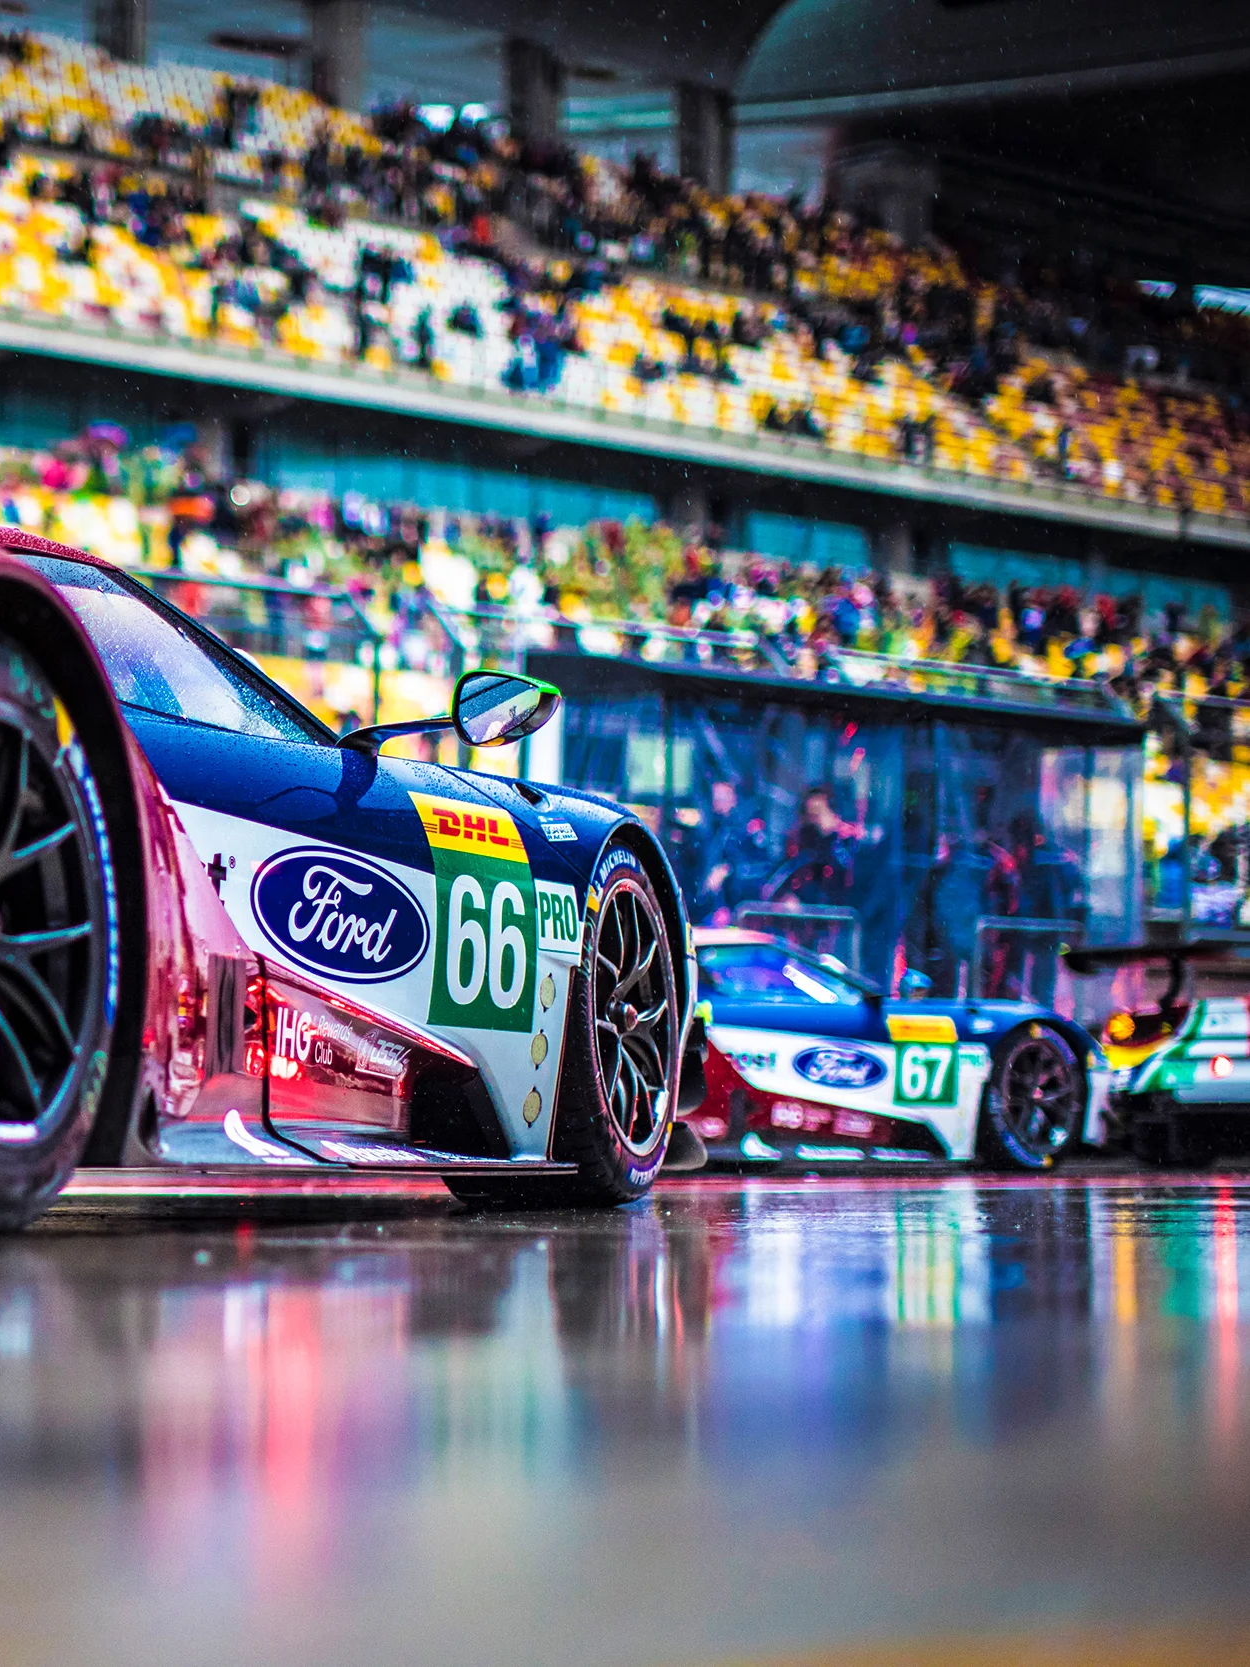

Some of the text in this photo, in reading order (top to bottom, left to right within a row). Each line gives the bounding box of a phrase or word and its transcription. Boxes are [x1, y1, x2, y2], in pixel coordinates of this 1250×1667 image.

[432, 808, 509, 847] DHL
[600, 850, 637, 884] MICHELIN
[288, 865, 398, 963] Ford
[538, 891, 579, 943] PRO
[446, 874, 527, 1009] 66
[275, 1006, 313, 1061] IHG
[314, 1042, 333, 1066] Club
[315, 1015, 353, 1041] Rewards
[901, 1045, 952, 1100] 67
